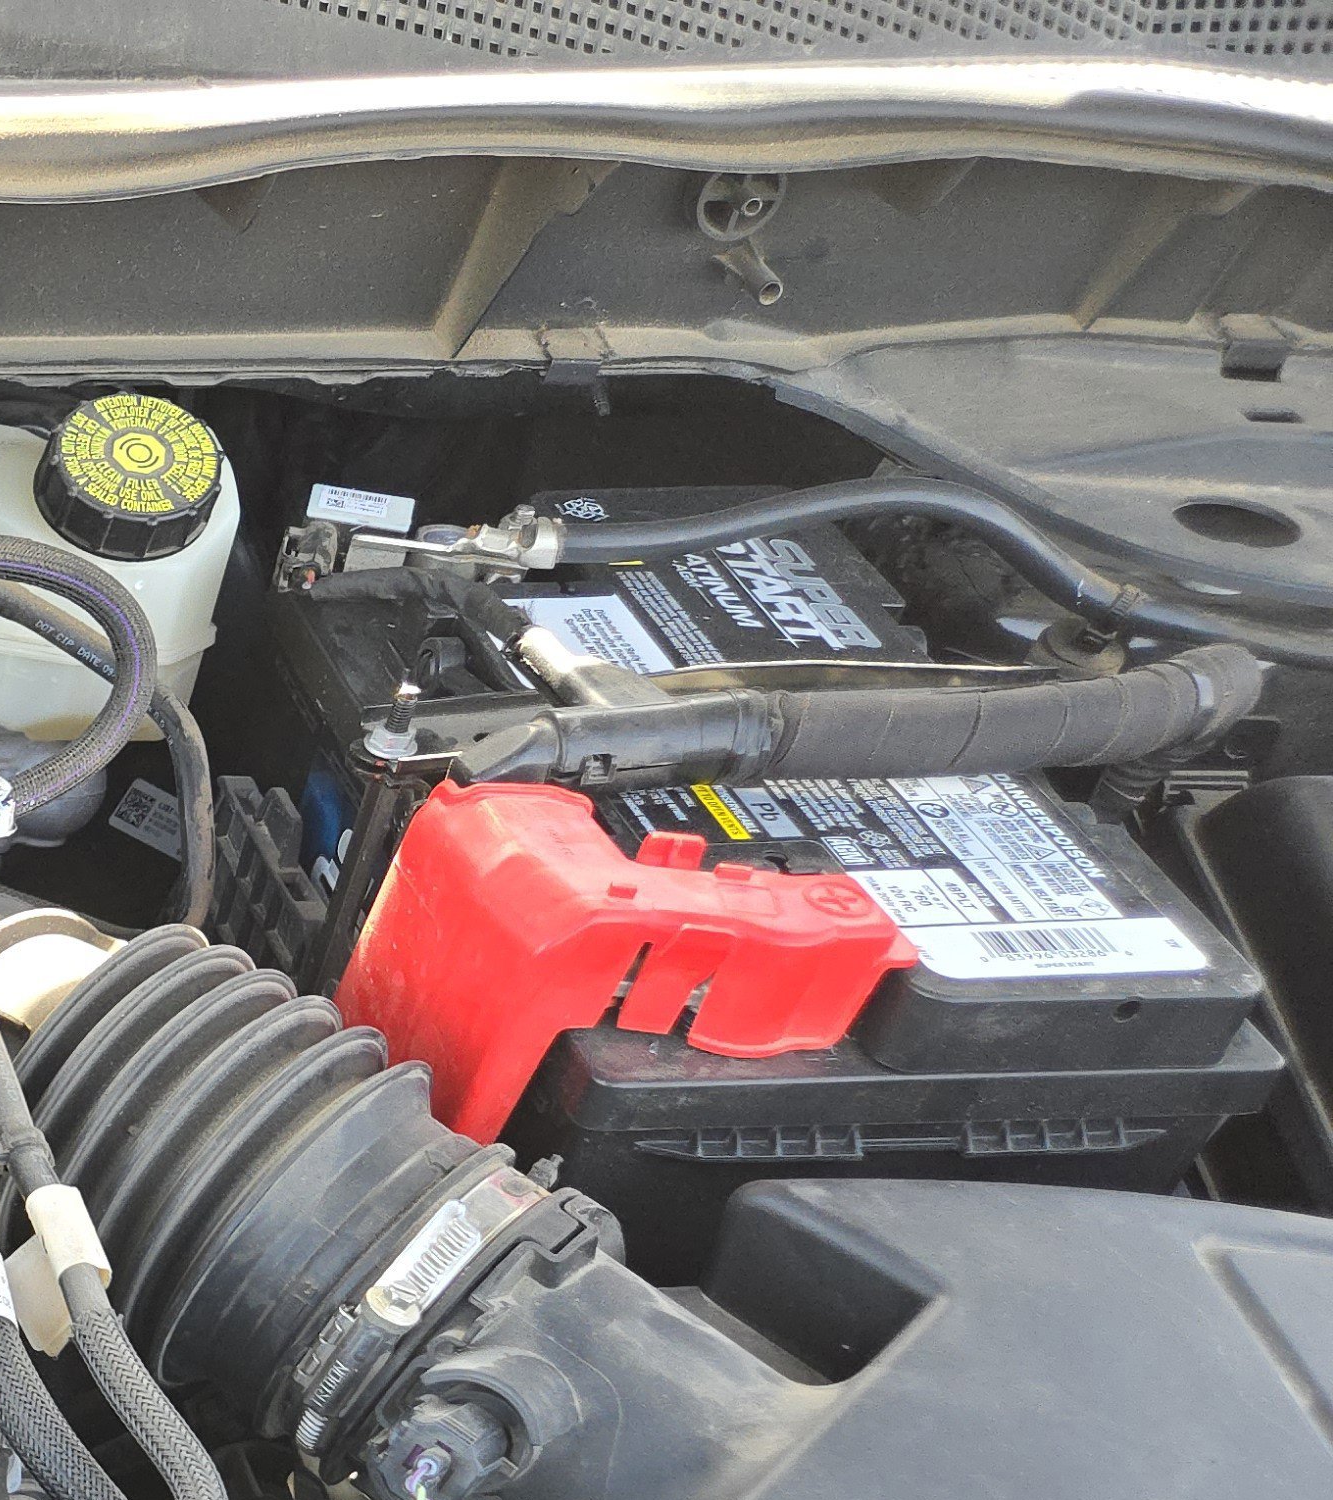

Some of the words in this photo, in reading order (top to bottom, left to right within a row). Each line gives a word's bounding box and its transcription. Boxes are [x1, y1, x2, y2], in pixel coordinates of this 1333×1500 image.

[141, 396, 184, 418] NETTOYER
[179, 414, 195, 425] LE
[151, 411, 168, 421] QUE
[166, 416, 179, 428] DU
[188, 449, 202, 459] DE
[64, 456, 82, 477] FROM
[77, 477, 89, 485] A
[84, 482, 119, 506] SEALED
[121, 500, 174, 512] CONTAINER
[82, 460, 119, 492] REMOVING
[119, 487, 139, 500] USE
[141, 490, 164, 500] ONLY
[96, 462, 124, 484] CLEAN
[125, 478, 160, 490] FILLER
[716, 537, 848, 652] START
[768, 538, 883, 649] SUPER
[77, 646, 104, 668] DATE
[749, 802, 783, 821] Pb
[989, 773, 1106, 877] DANGER/POISON
[825, 837, 867, 862] AGM
[1008, 864, 1039, 886] MEDICAL
[1031, 888, 1053, 901] HELP
[1041, 863, 1083, 896] IMMEDIATELY
[885, 885, 908, 898] 120
[898, 900, 918, 912] RC
[908, 890, 933, 906] 760
[941, 881, 977, 909] 48PLT
[1007, 952, 1054, 962] 83996
[1056, 950, 1108, 959] 03286
